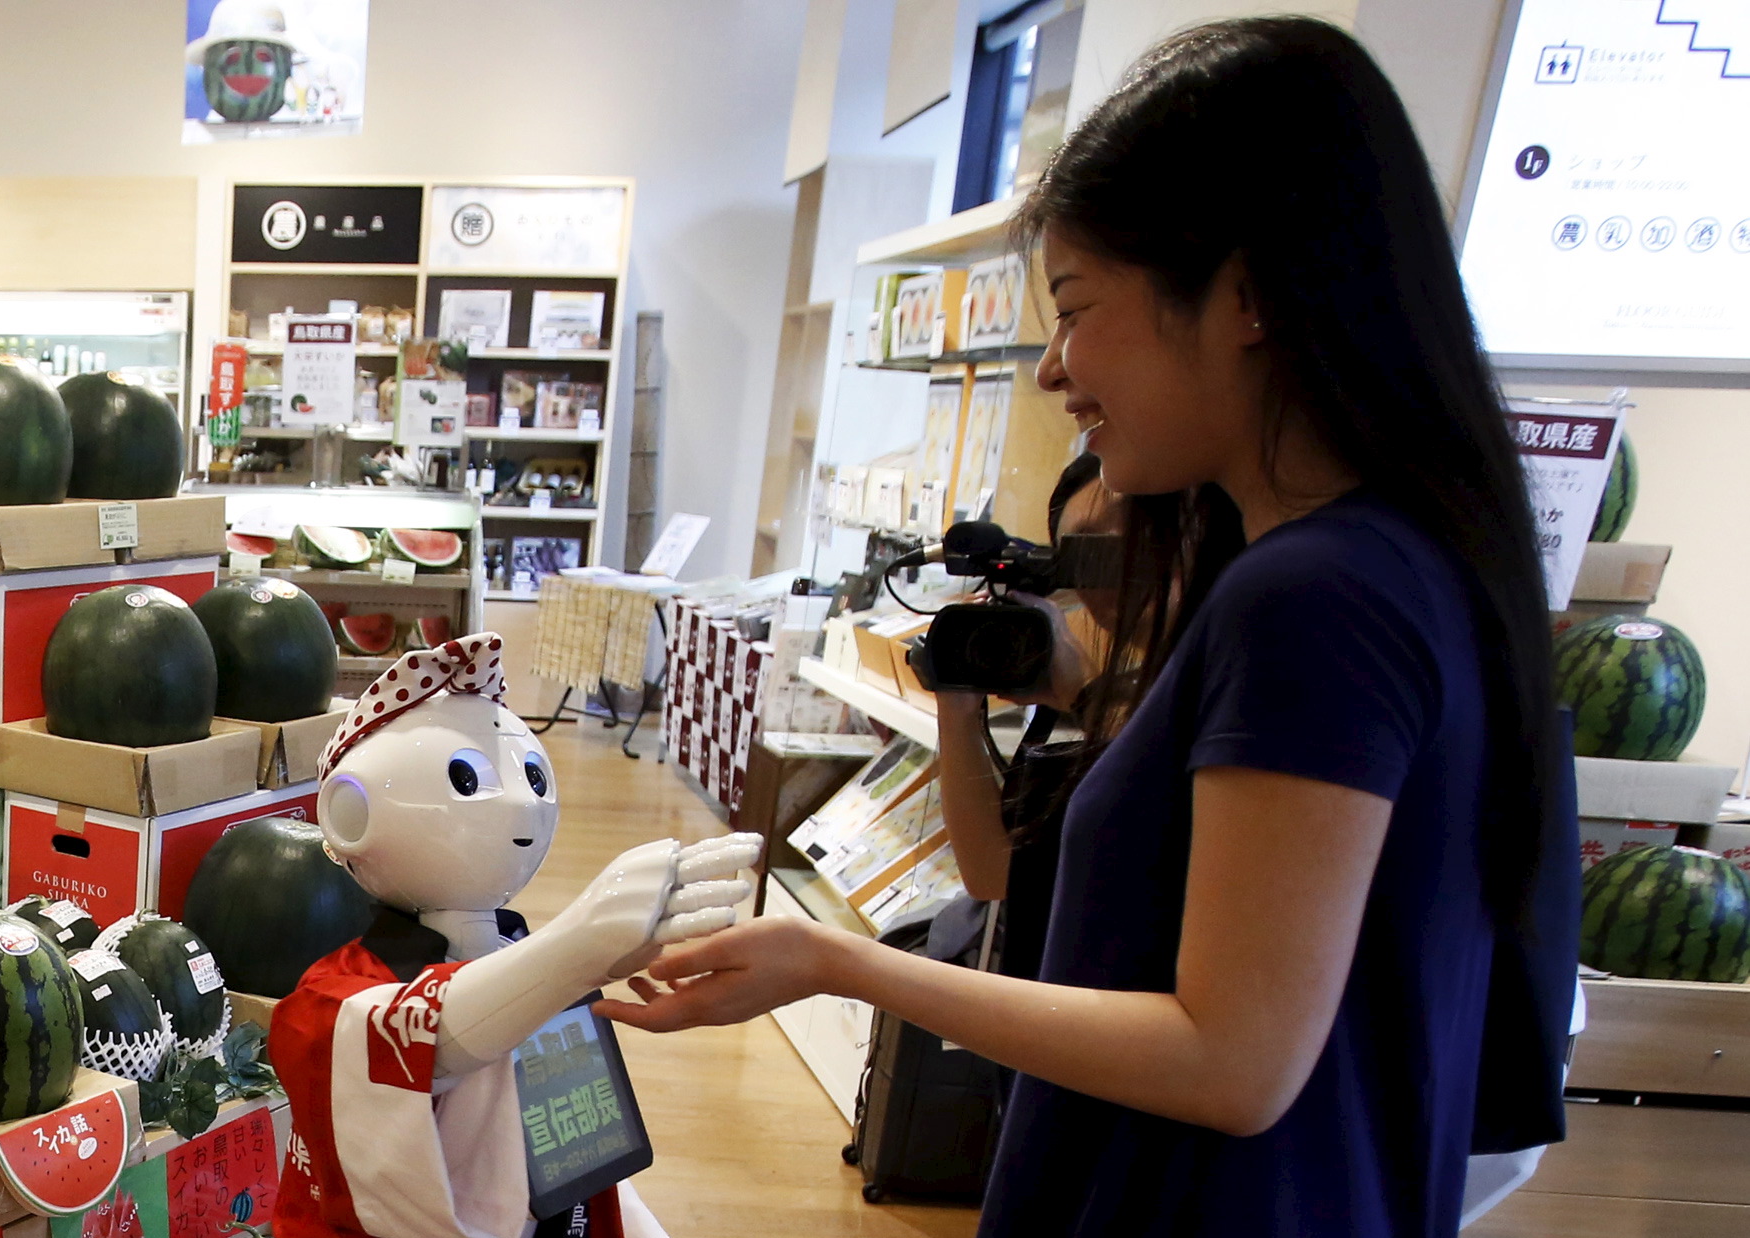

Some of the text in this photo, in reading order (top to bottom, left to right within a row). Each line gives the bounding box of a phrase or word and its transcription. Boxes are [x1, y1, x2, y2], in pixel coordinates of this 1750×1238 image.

[1588, 48, 1666, 64] Elevator
[32, 869, 108, 900] GABURIKO
[231, 1125, 249, 1163] 甘い
[521, 1075, 622, 1157] 宣伝部長
[173, 1155, 192, 1236] スイカ
[212, 1133, 230, 1207] 鳥取の
[249, 1117, 271, 1210] 瑞々しくて
